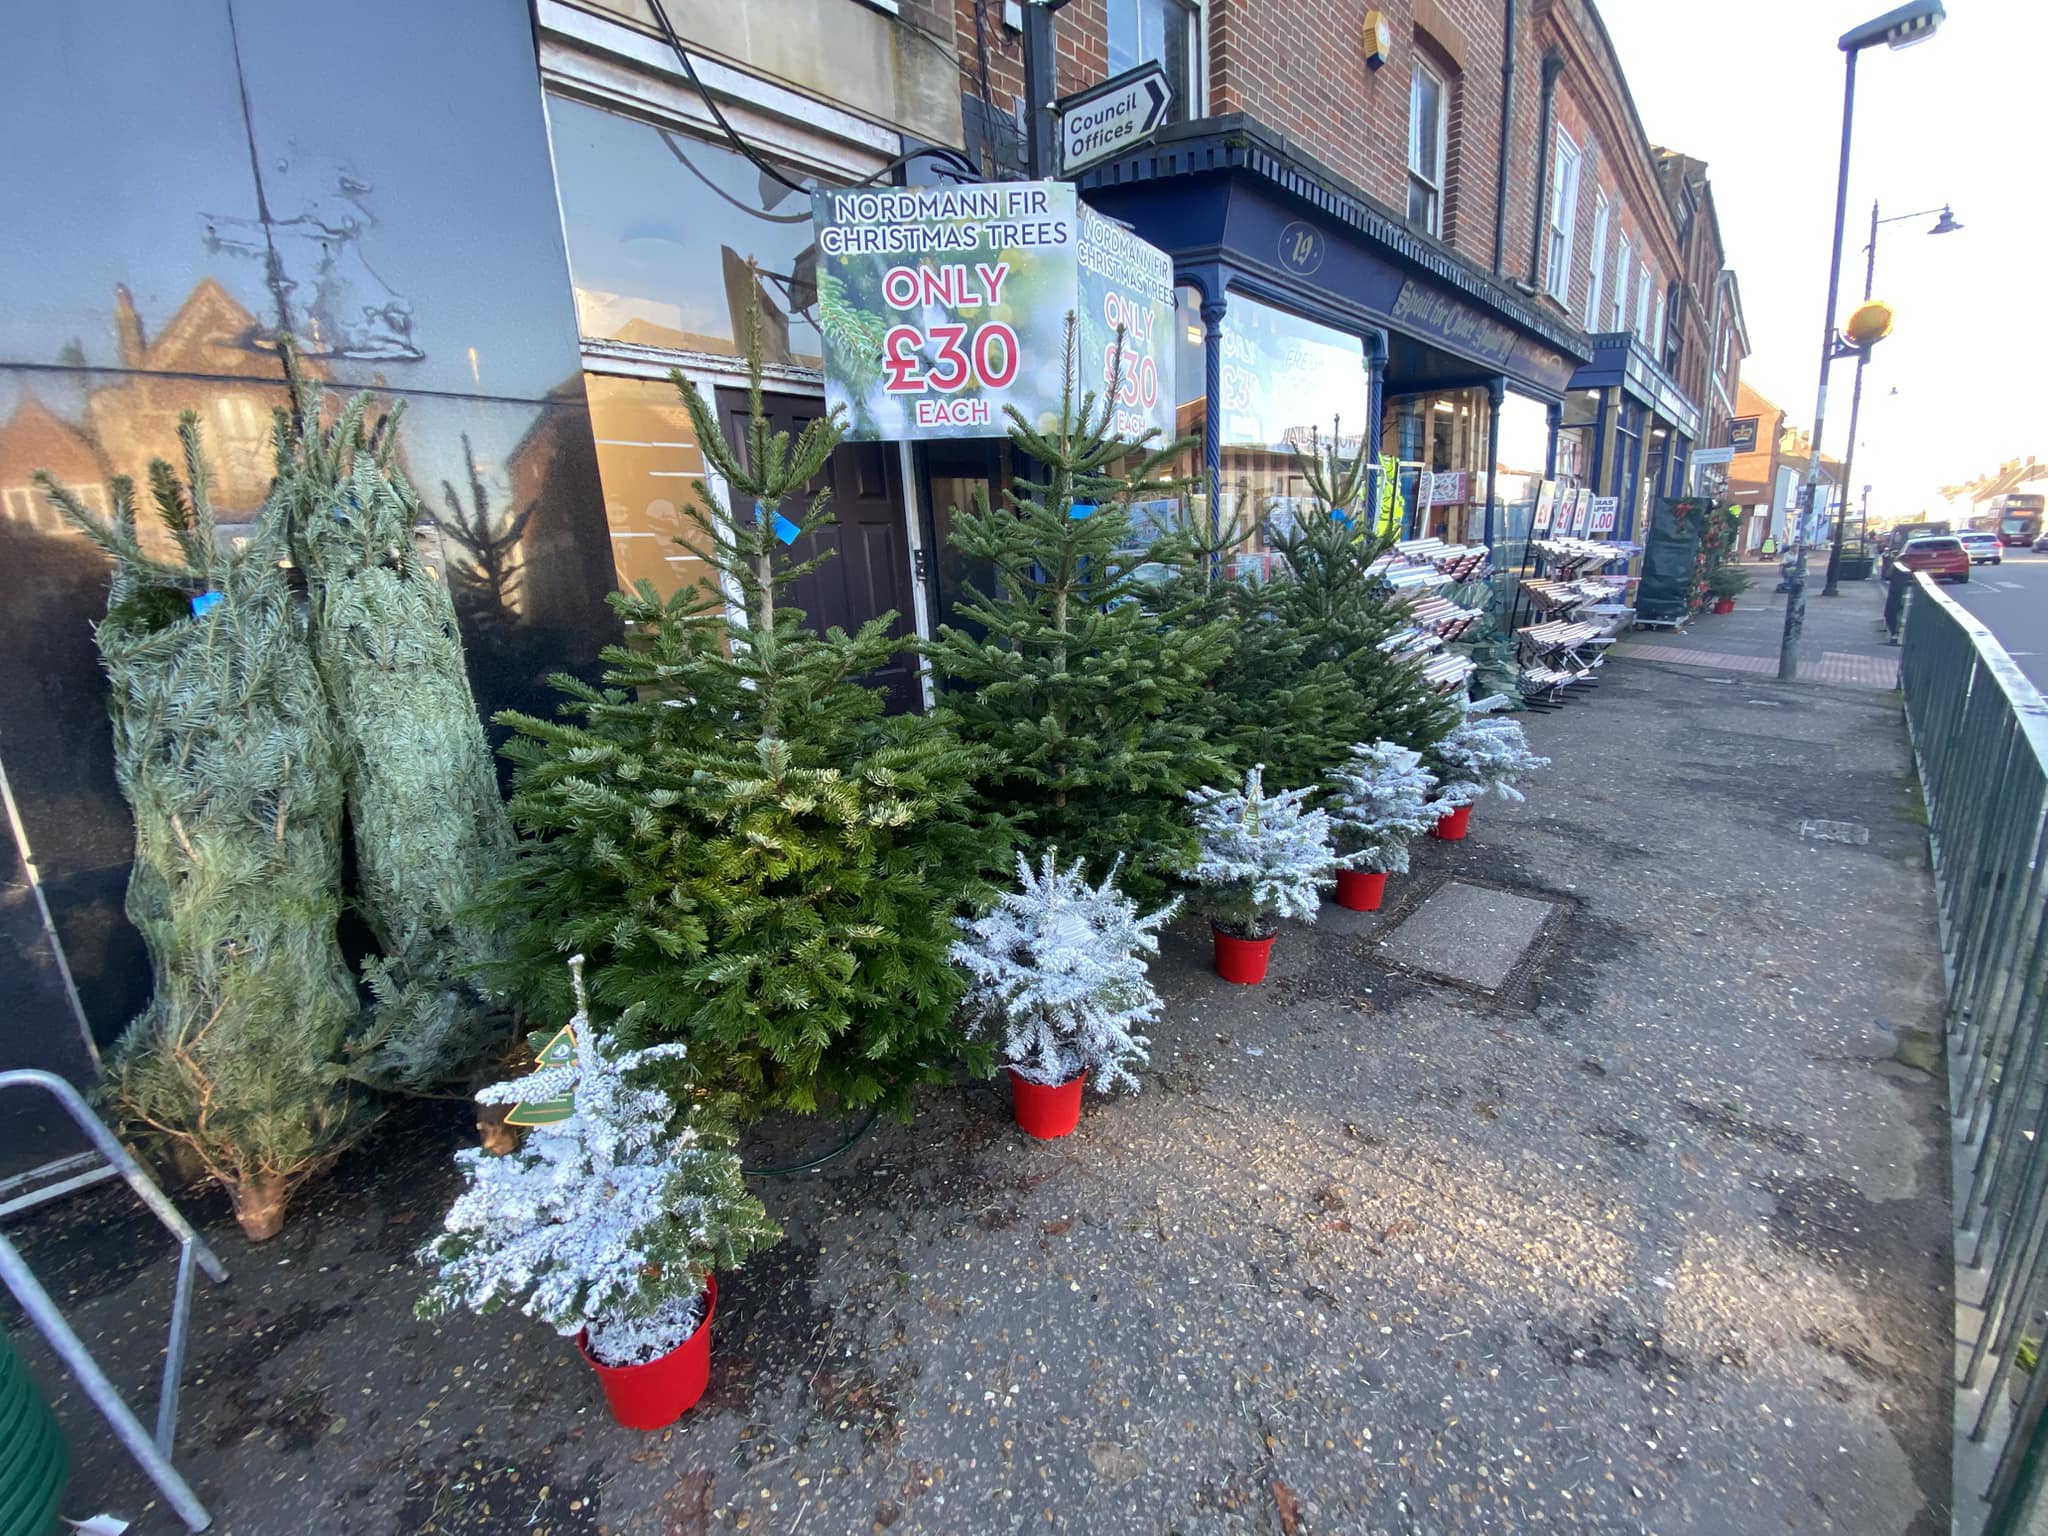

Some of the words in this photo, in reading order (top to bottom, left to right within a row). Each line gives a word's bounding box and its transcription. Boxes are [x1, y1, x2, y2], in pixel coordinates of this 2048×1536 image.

[1071, 92, 1137, 134] Council
[1072, 119, 1133, 157] Offices
[836, 193, 1000, 222] NORDMANN
[1009, 190, 1048, 214] FIR
[822, 225, 977, 253] CHRISTMAS
[989, 222, 1067, 247] TREES
[1084, 216, 1151, 270] NORDMANN
[1154, 258, 1169, 280] FIR
[1292, 231, 1313, 265] 19
[884, 265, 1008, 308] ONLY
[1077, 241, 1144, 291] CHRISTMAS
[1145, 276, 1175, 307] TREES
[1104, 292, 1155, 342] ONLY
[885, 322, 1018, 392] £30
[918, 400, 988, 424] EACH
[1117, 411, 1146, 433] EACH
